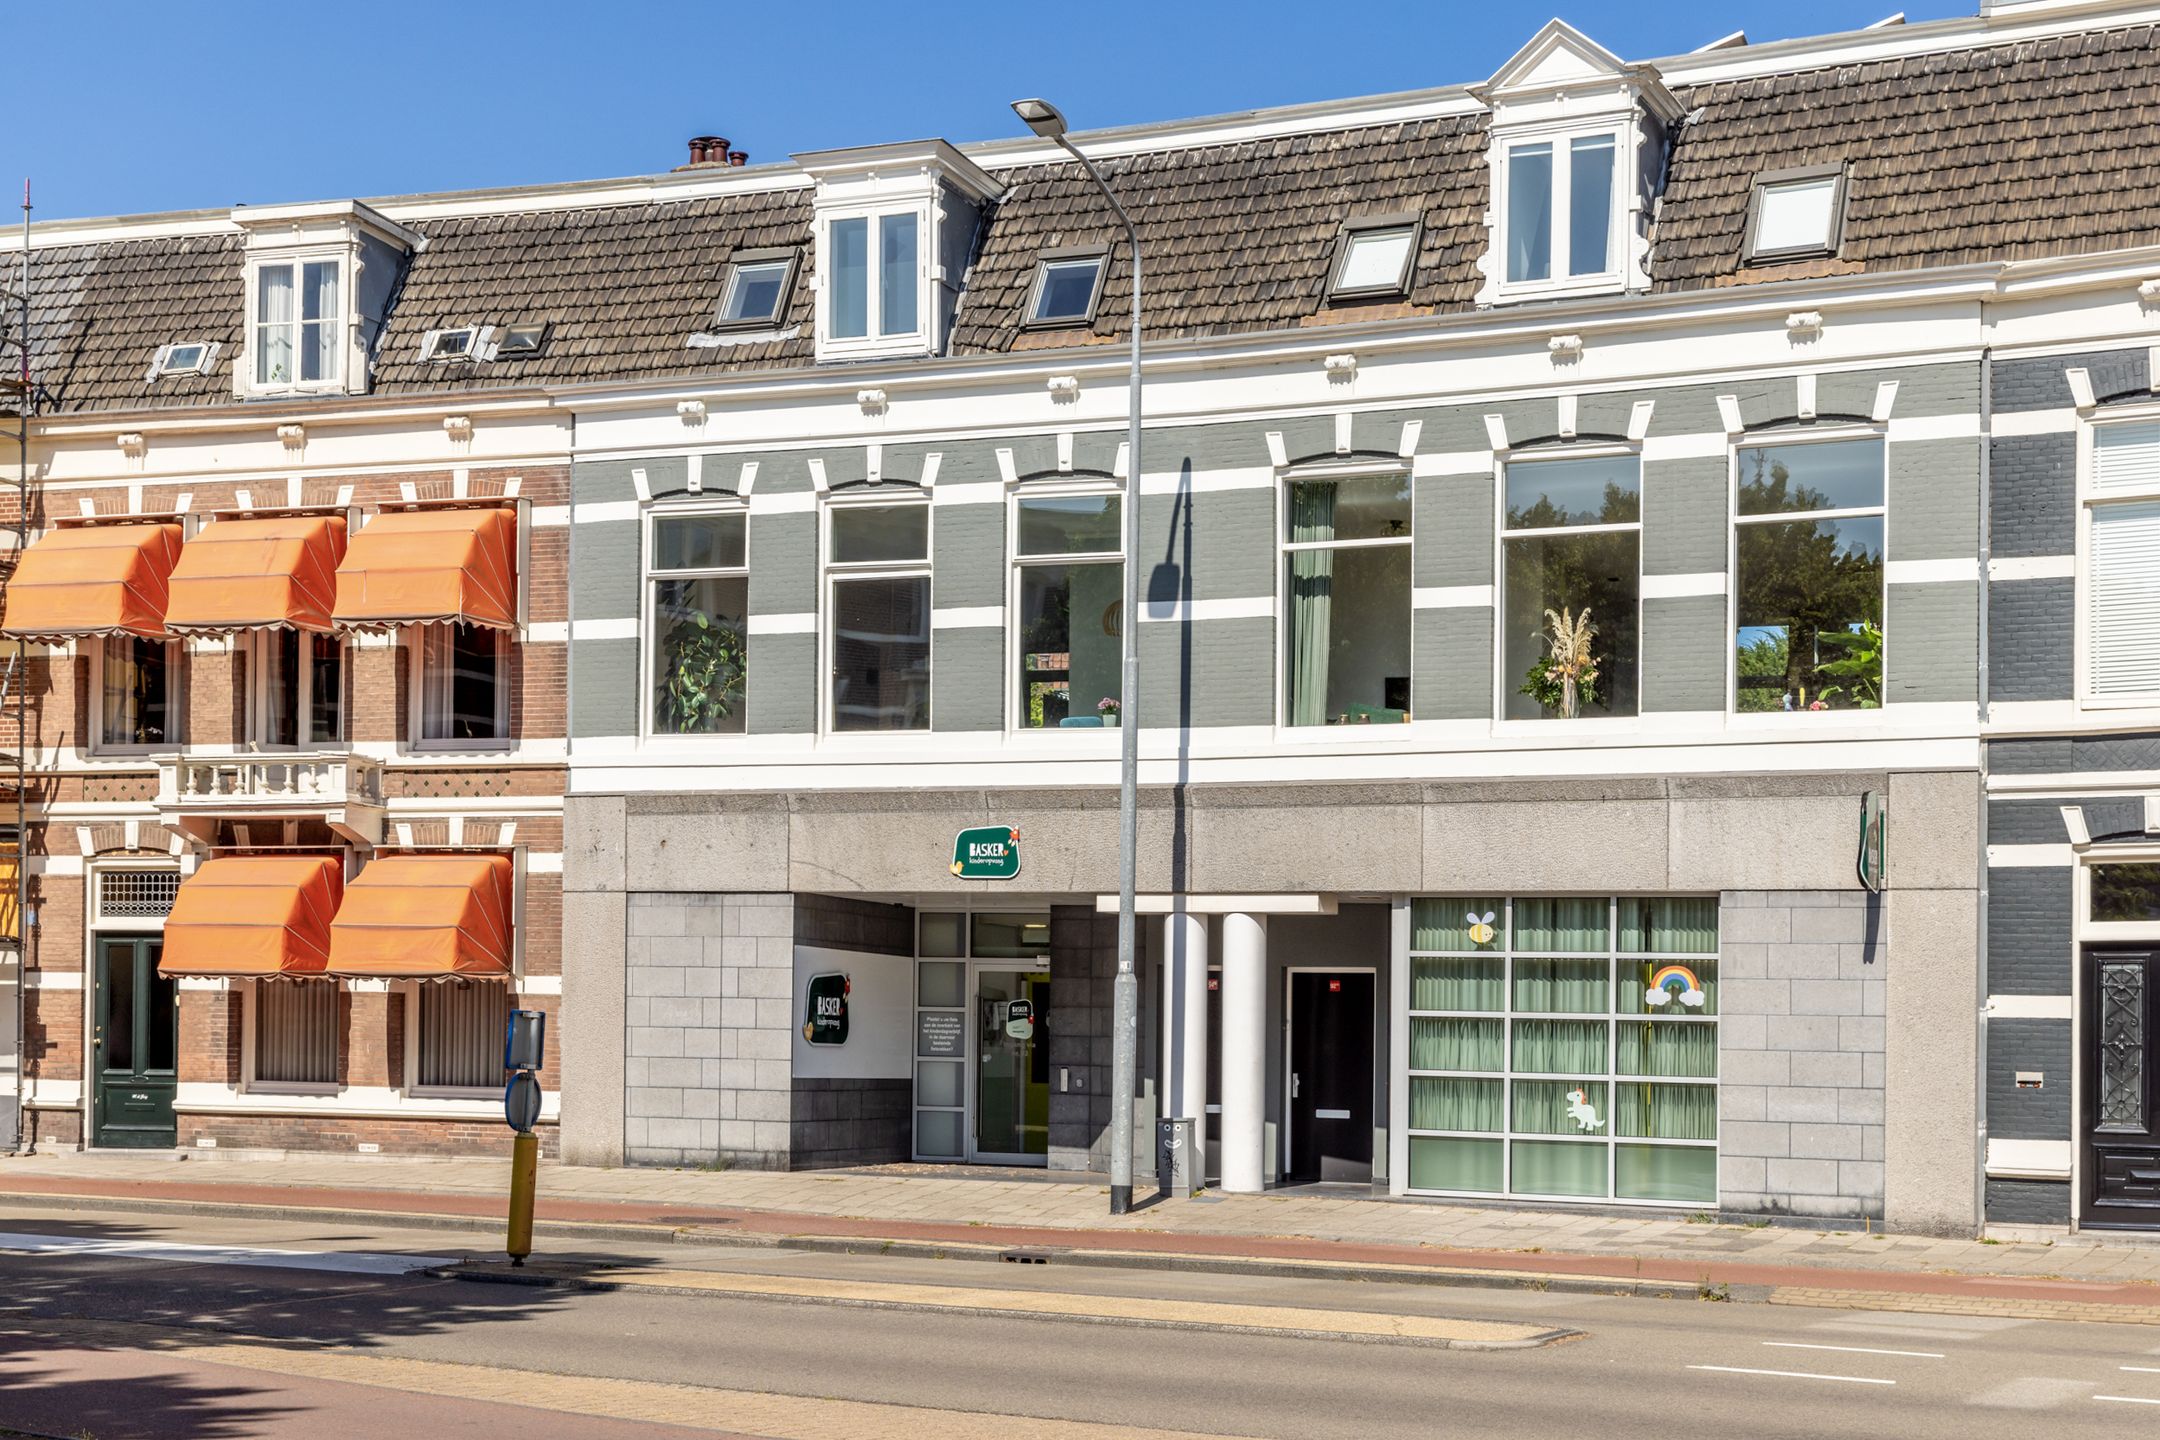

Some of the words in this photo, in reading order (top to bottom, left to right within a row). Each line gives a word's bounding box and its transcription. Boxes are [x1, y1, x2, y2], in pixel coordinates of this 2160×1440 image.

[969, 843, 1004, 857] BASKER
[969, 857, 1004, 866] kinderopvang
[817, 996, 840, 1015] BASKER
